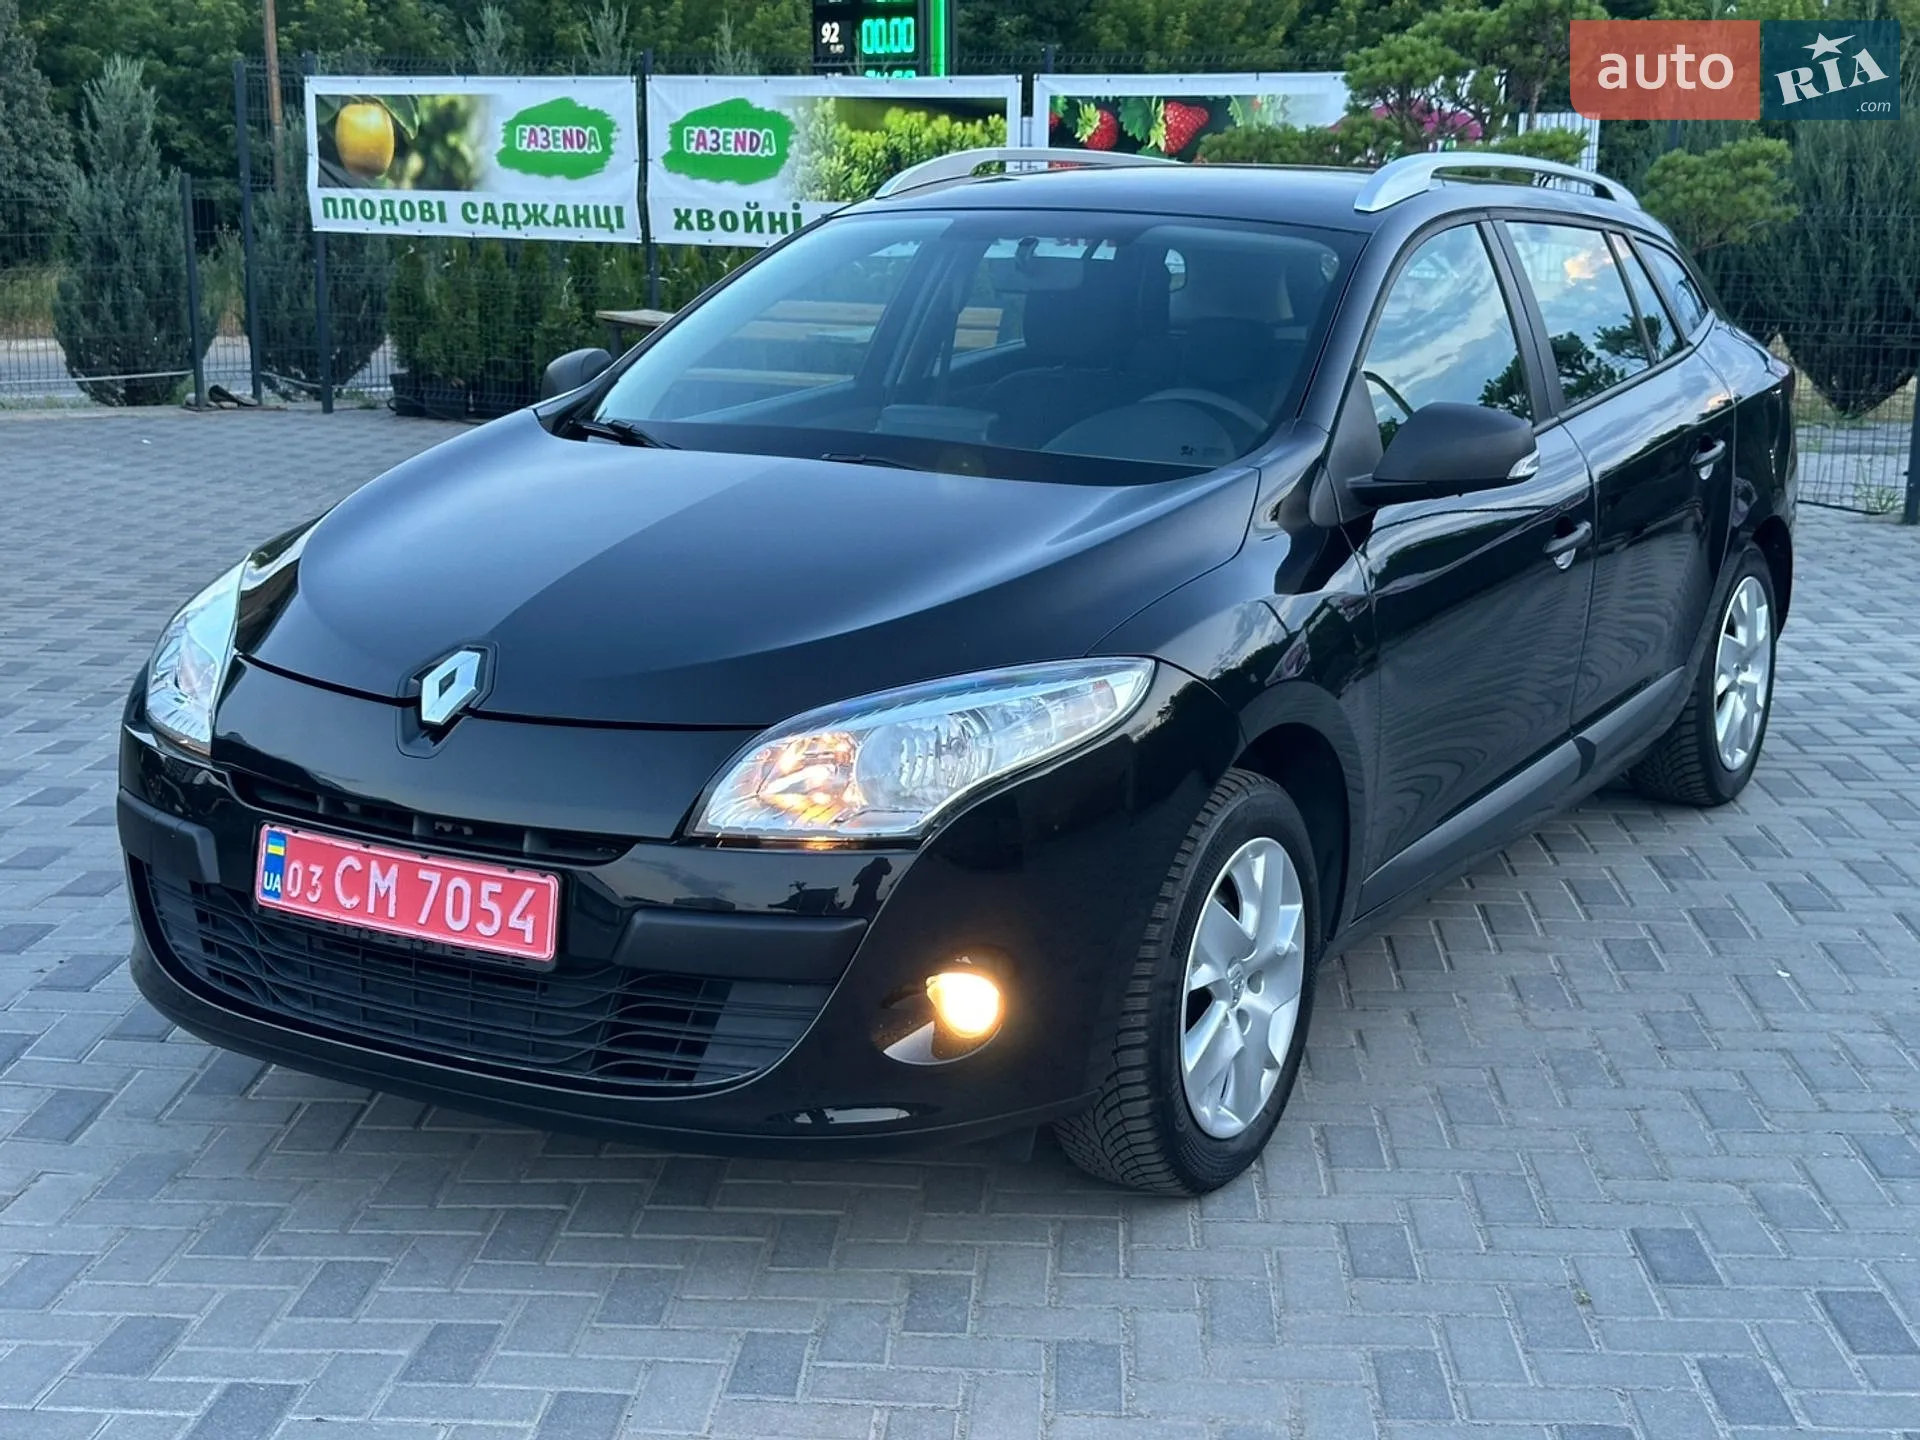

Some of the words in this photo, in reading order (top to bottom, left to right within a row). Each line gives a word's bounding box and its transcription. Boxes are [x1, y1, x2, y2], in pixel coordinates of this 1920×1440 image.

[821, 22, 840, 44] 92
[322, 197, 447, 226] ПЛОДОВІ
[460, 201, 626, 233] САДЖАНЦІ
[263, 871, 282, 893] UA
[286, 858, 325, 903] 03
[333, 855, 400, 919] CM
[416, 869, 537, 945] 7054
